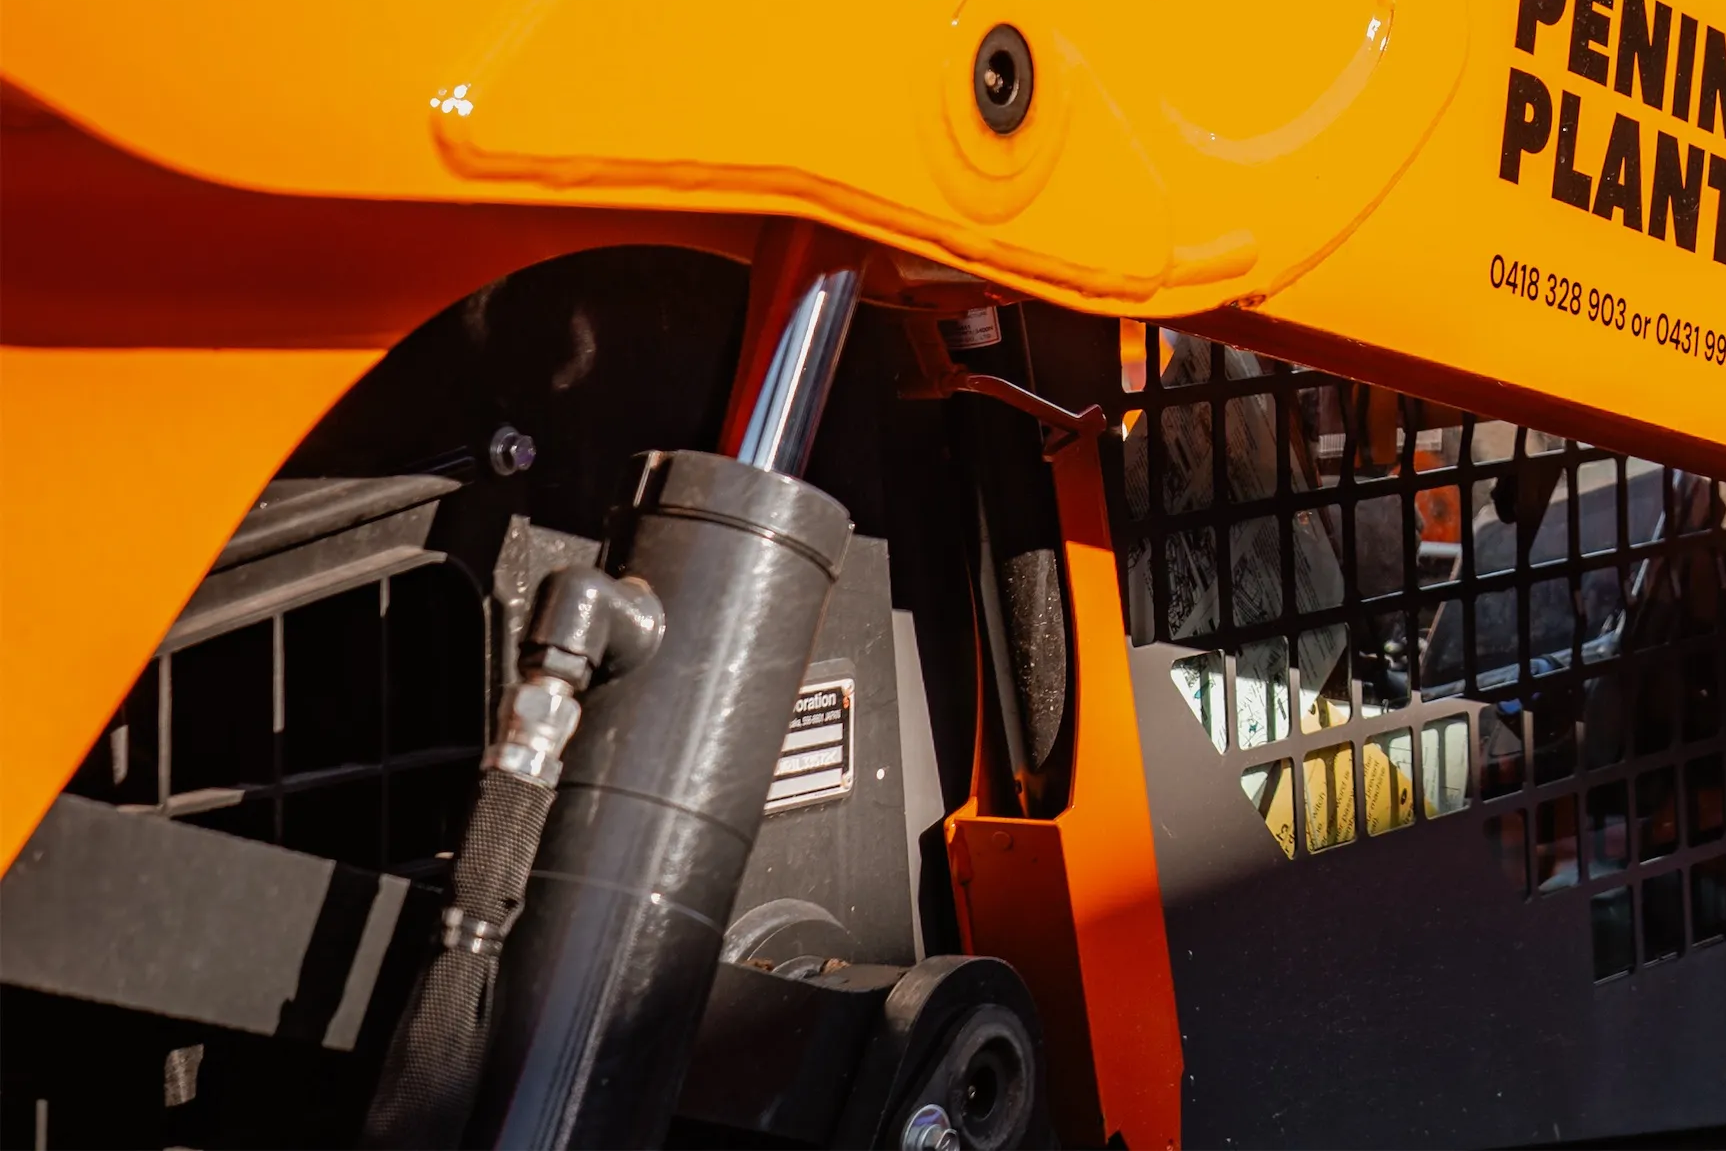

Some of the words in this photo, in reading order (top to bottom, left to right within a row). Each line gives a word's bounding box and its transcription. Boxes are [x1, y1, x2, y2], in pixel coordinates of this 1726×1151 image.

[1490, 254, 1540, 302] 0418
[1545, 273, 1582, 316] 328
[1588, 288, 1627, 332] 903
[1631, 312, 1652, 340] or
[1656, 313, 1700, 357] 0431
